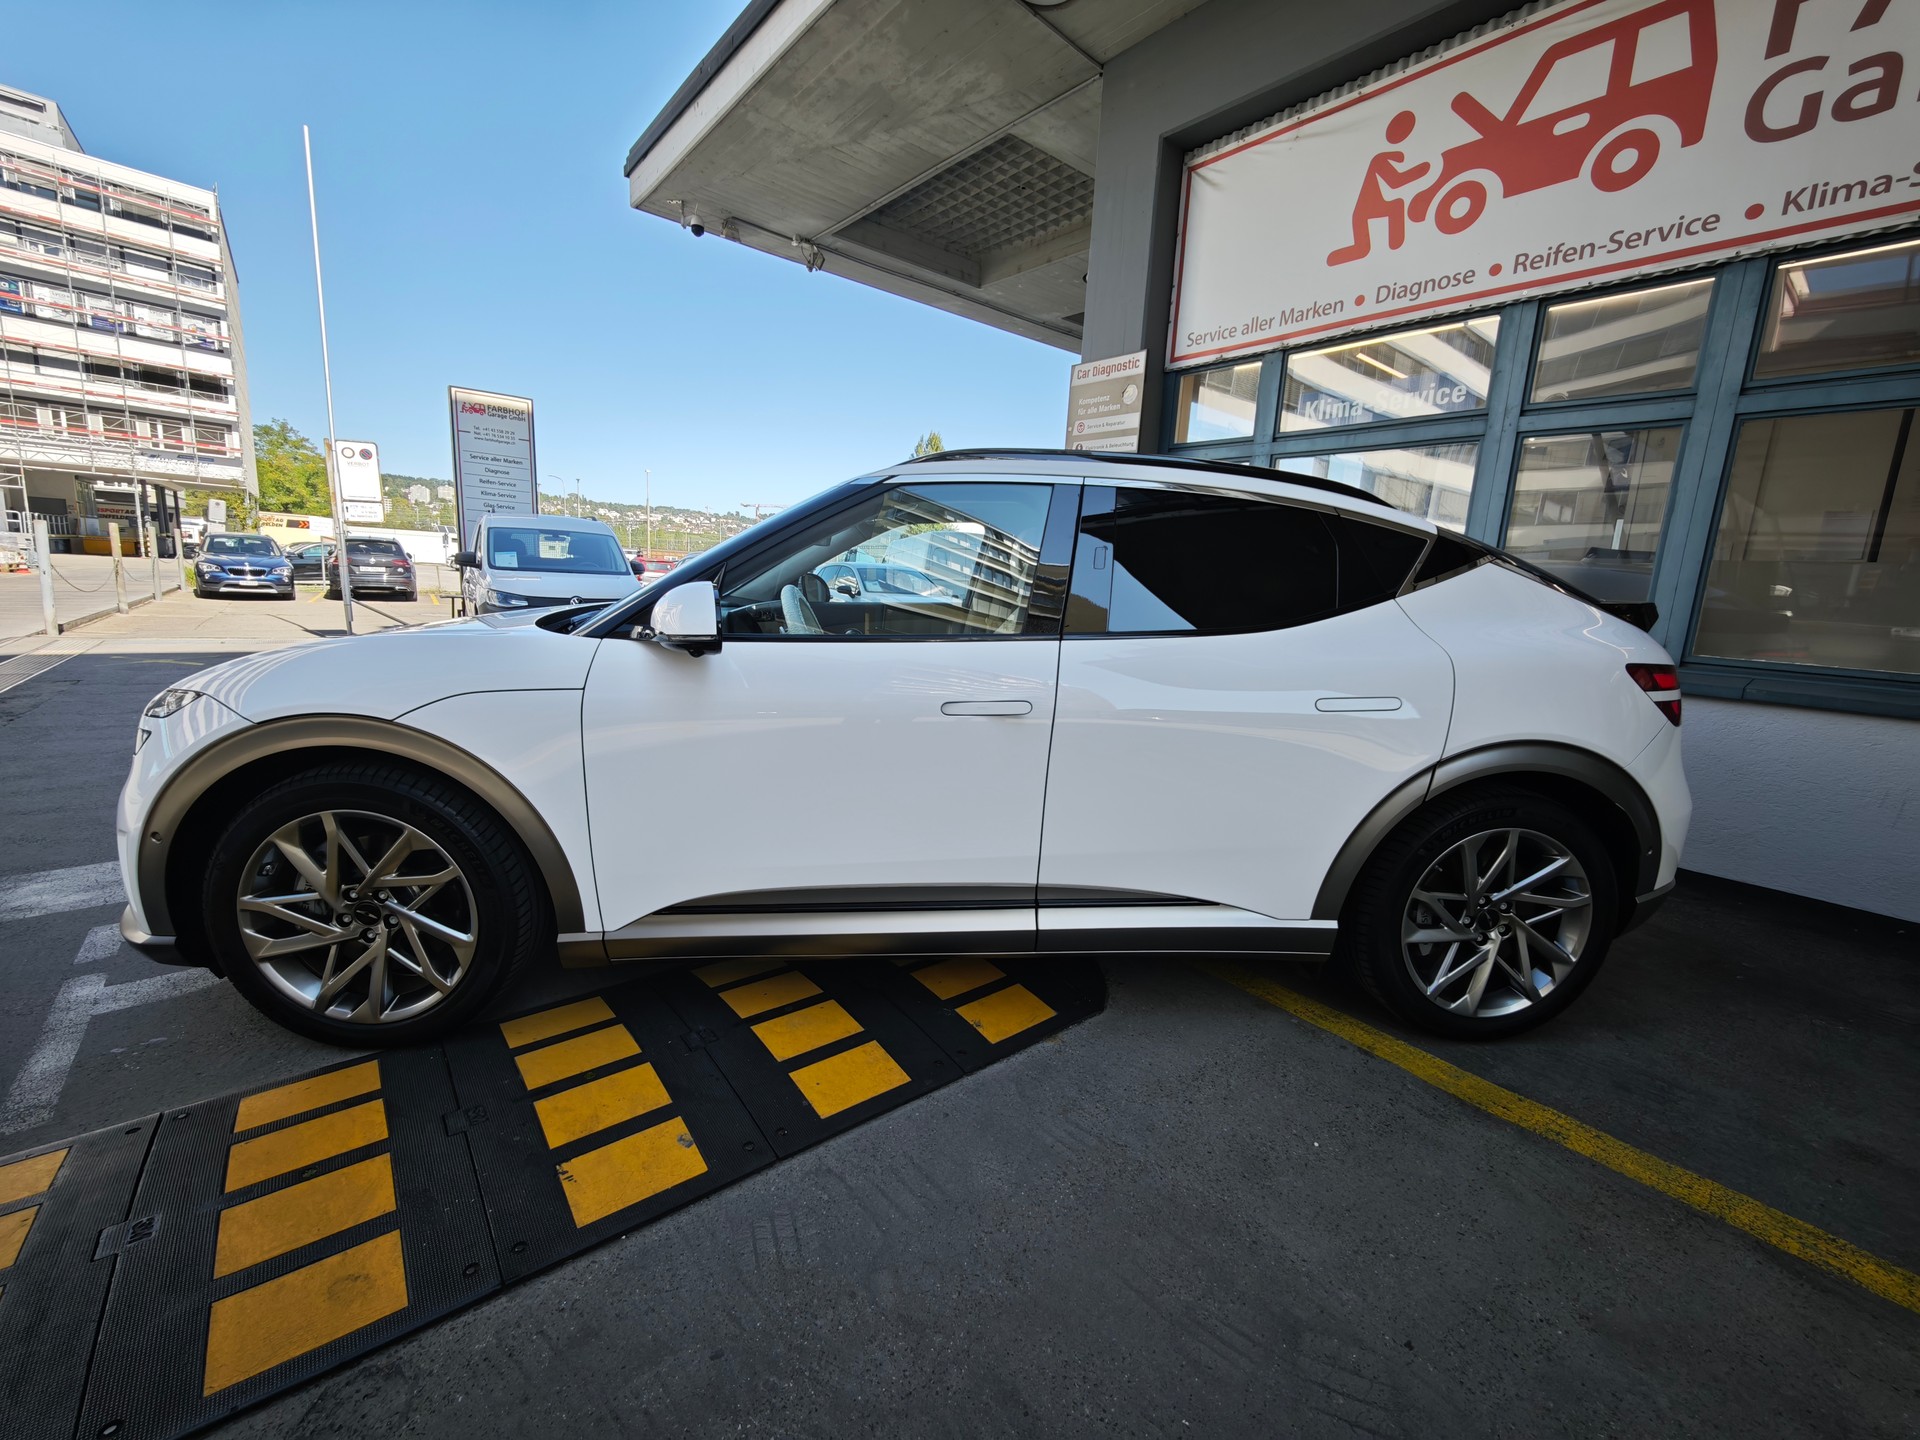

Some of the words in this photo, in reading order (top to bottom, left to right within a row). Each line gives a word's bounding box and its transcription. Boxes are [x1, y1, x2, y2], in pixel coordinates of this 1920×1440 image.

[1744, 51, 1920, 143] Ga
[1186, 323, 1237, 348] Service
[1241, 316, 1276, 336] aller
[1278, 300, 1345, 327] Marken
[1374, 269, 1476, 304] Diagnose
[1512, 213, 1721, 275] Reifen-Service
[1077, 369, 1091, 380] Car
[1092, 357, 1141, 377] Diagnostic
[1079, 394, 1110, 406] Kompetenz
[1304, 382, 1468, 424] Klima-Service
[487, 404, 526, 417] FARBHOF
[1098, 403, 1121, 412] Marken
[487, 411, 508, 420] Garage
[470, 454, 490, 462] Service
[484, 467, 510, 476] Diagnose
[479, 478, 517, 488] Reifen-Service
[480, 490, 517, 499] Klima-Service
[483, 502, 516, 511] Glas-Service
